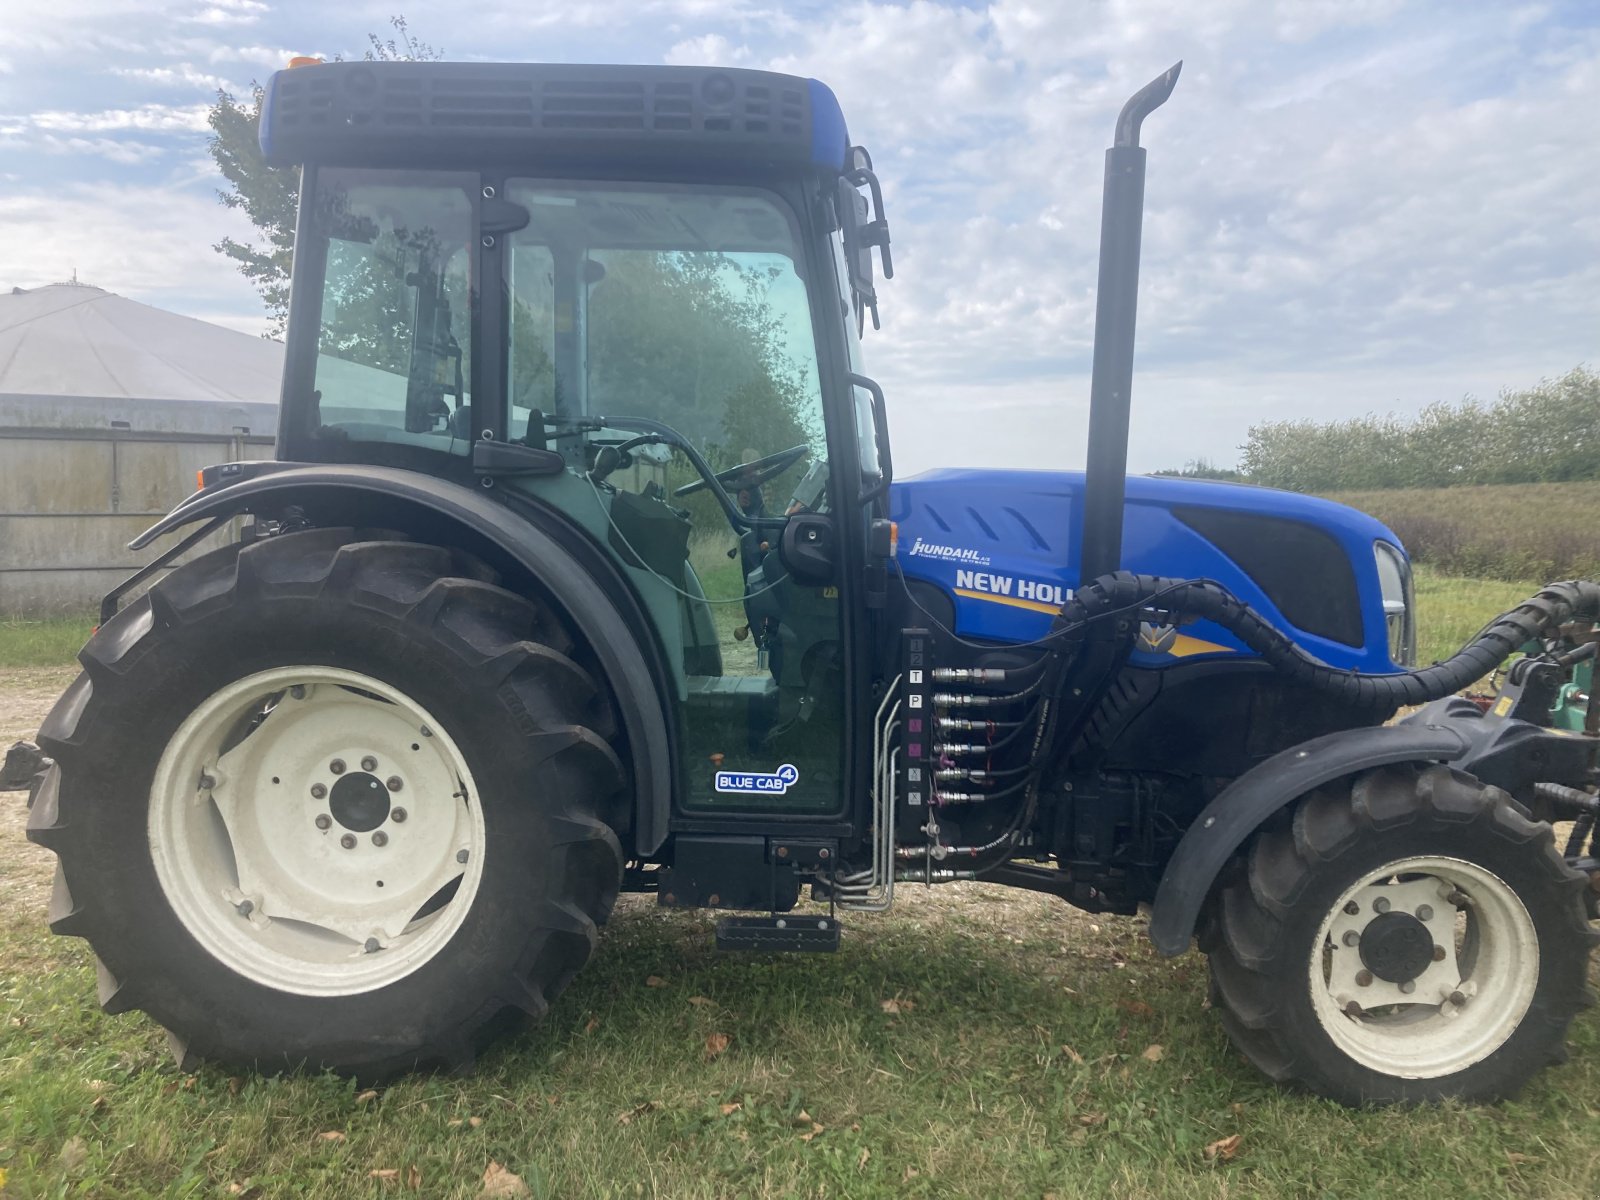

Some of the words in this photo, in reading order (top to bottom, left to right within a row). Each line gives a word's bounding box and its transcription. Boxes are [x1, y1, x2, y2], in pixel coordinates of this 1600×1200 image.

[956, 569, 1013, 595] NEW
[913, 654, 921, 665] 2
[912, 671, 920, 682] T
[911, 696, 920, 706] P
[780, 768, 795, 780] 4
[719, 776, 754, 788] BLUE
[756, 778, 783, 790] CAB
